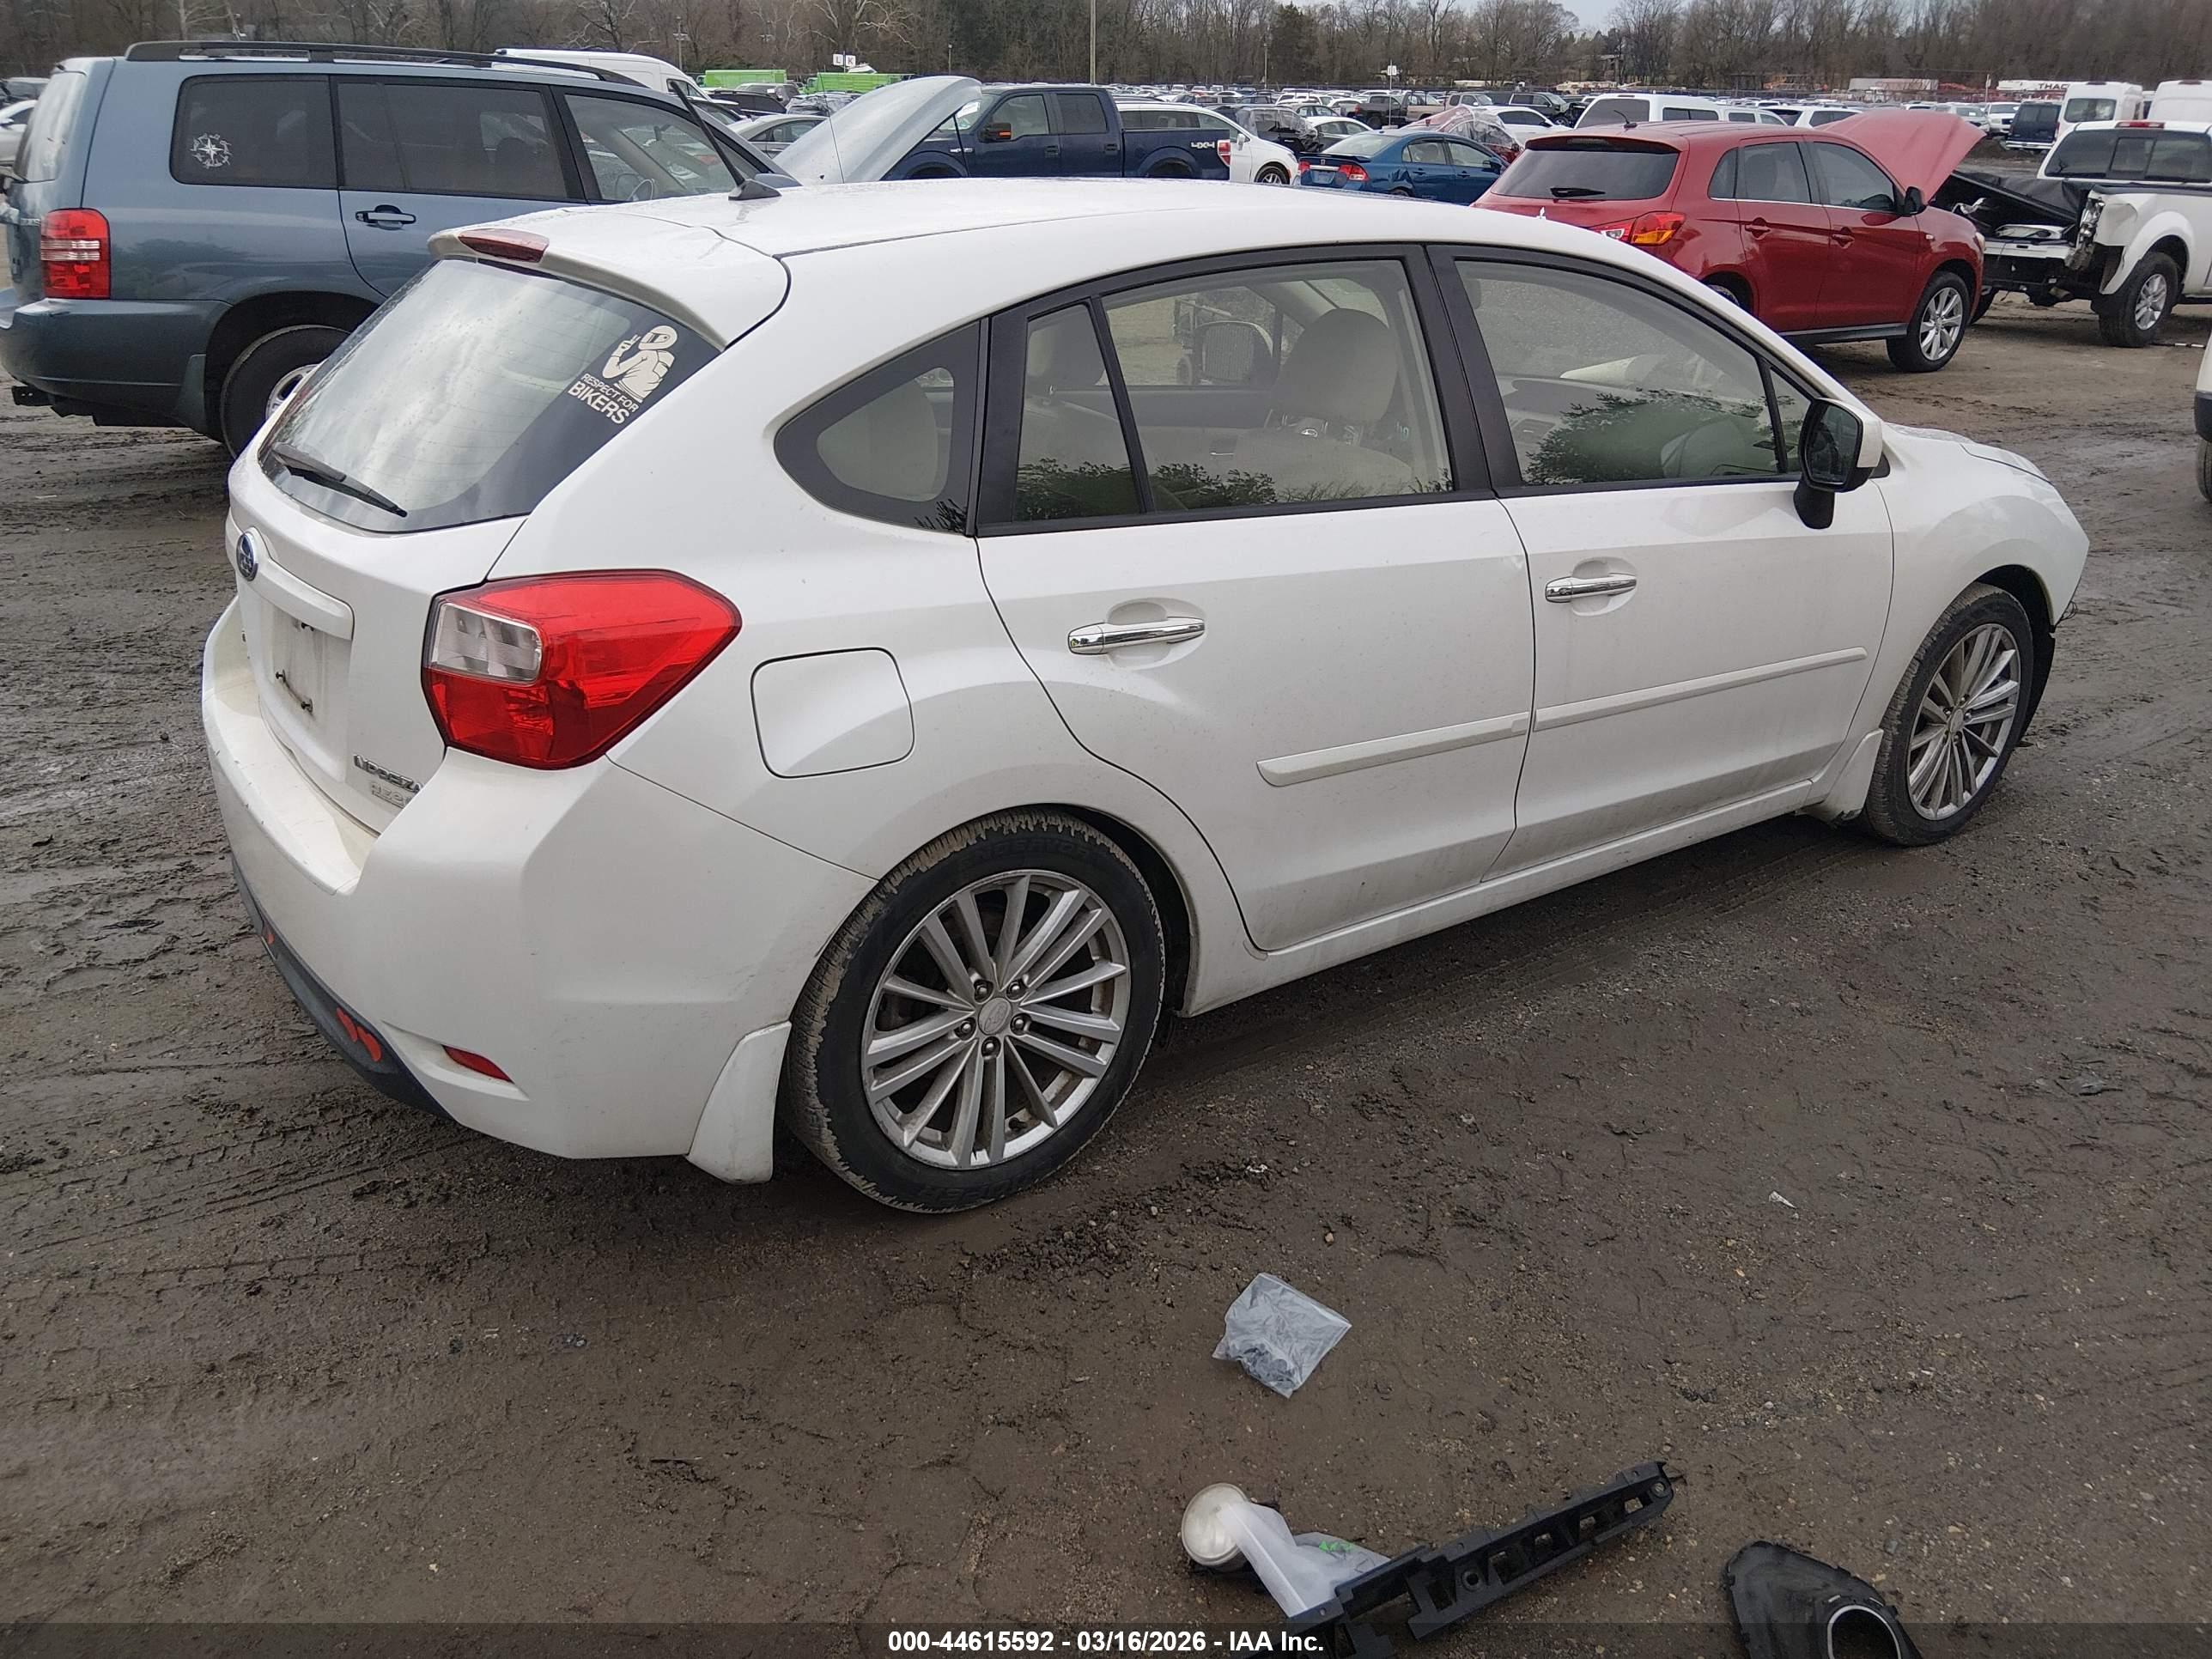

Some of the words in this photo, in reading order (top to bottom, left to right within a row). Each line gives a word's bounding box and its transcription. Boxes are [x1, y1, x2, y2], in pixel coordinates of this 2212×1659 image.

[568, 380, 630, 424] BIKERS
[580, 373, 621, 398] RESPECT
[617, 395, 640, 413] FOR
